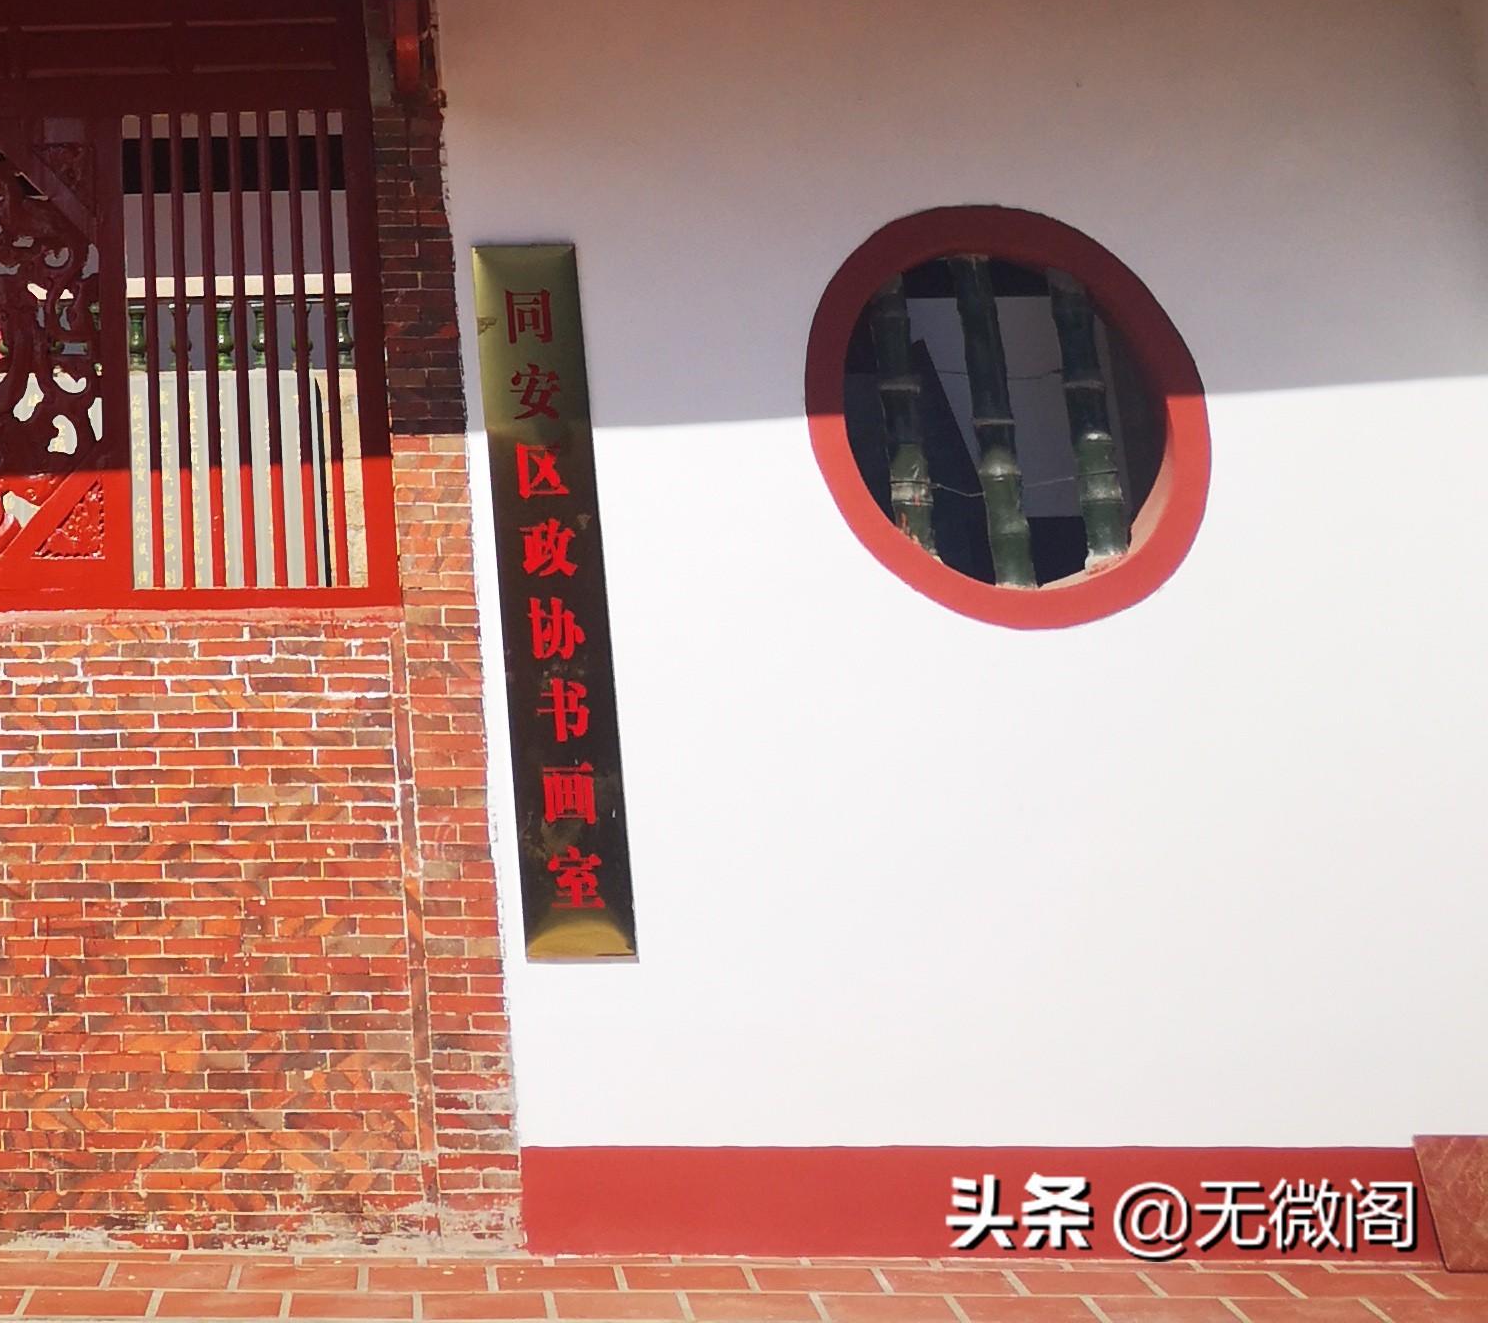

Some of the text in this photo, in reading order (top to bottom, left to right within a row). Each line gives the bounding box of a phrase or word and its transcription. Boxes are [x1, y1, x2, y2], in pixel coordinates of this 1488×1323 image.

[504, 287, 606, 912] 同安区政协书画室
